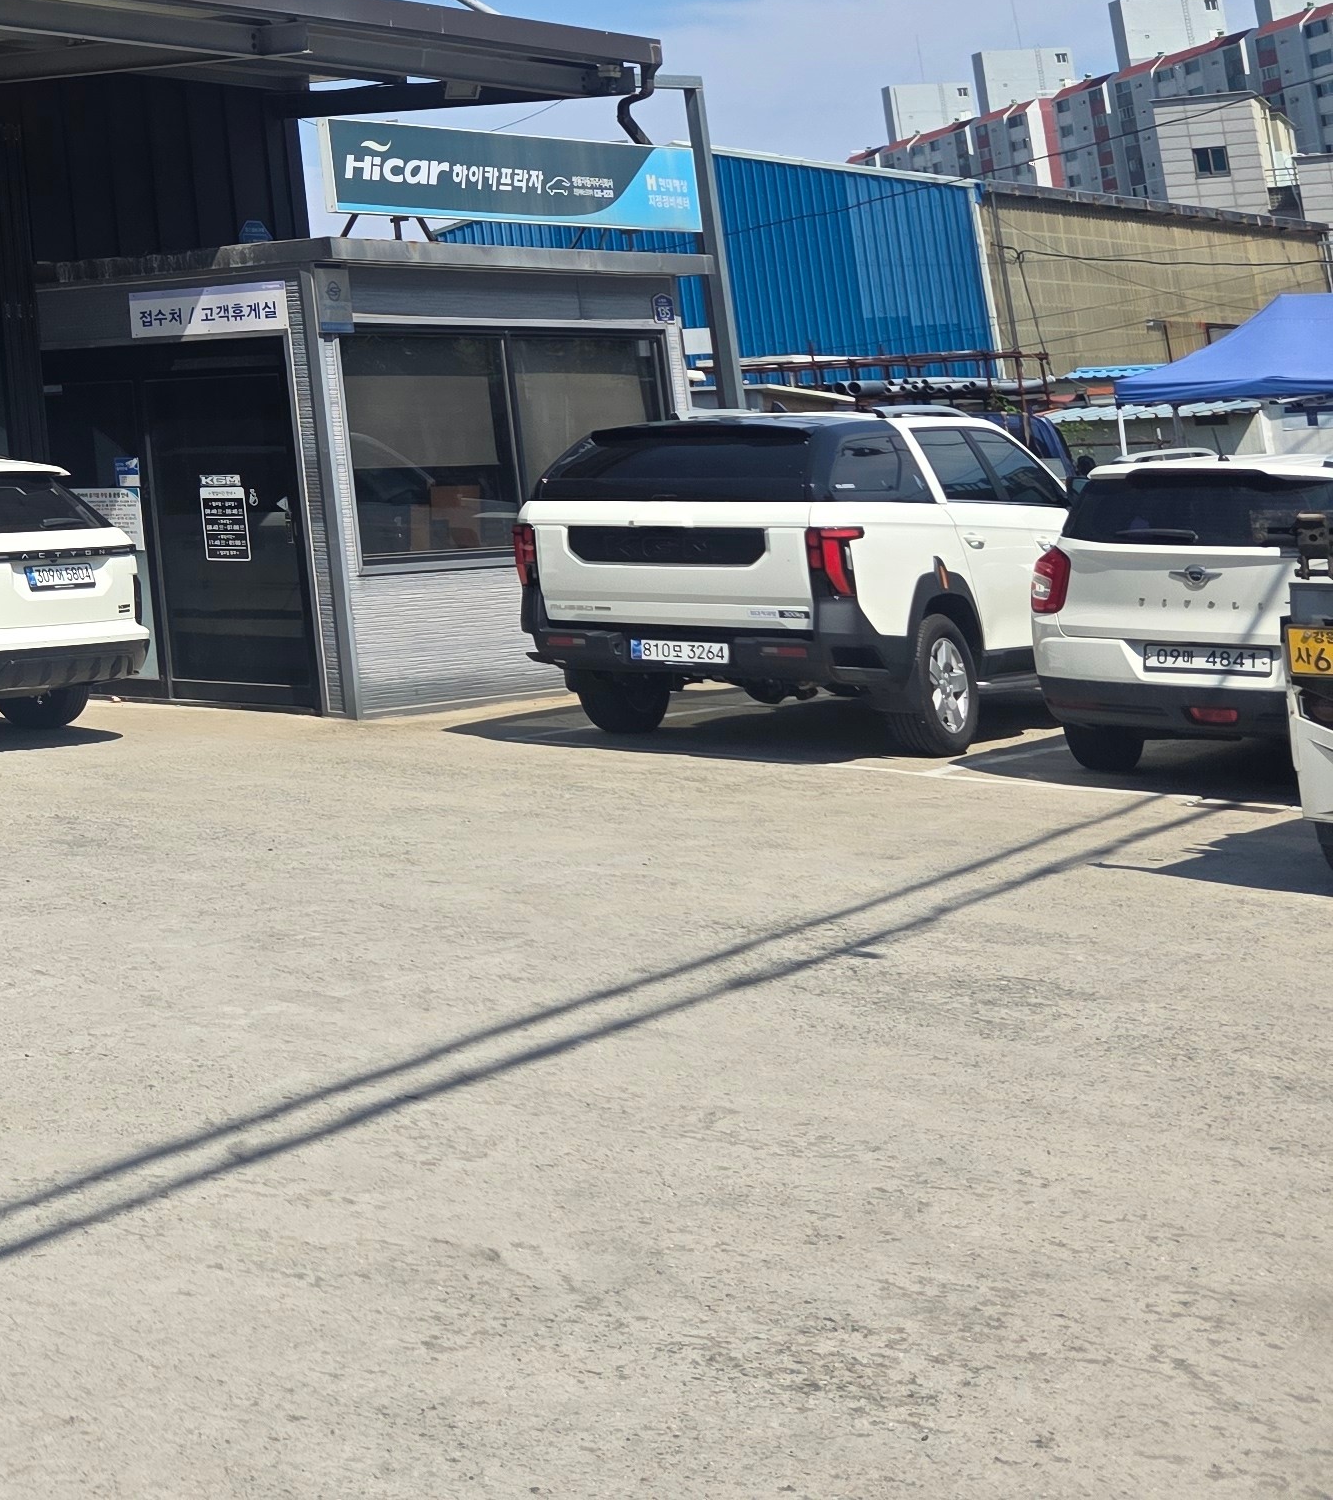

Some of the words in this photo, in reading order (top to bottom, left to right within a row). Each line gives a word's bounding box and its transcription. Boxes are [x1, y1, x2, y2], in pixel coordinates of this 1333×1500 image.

[345, 154, 450, 186] Hicar
[452, 163, 544, 194] 하이카프라자
[139, 308, 182, 327] 접수처
[188, 307, 195, 324] /
[200, 301, 278, 322] 고객휴게실
[200, 476, 239, 485] KGM
[21, 549, 106, 560] ACTYON
[66, 565, 92, 582] 5804
[642, 643, 683, 659] 810모
[687, 643, 725, 661] 3264
[1156, 648, 1194, 665] 09마
[1205, 650, 1257, 669] 4841
